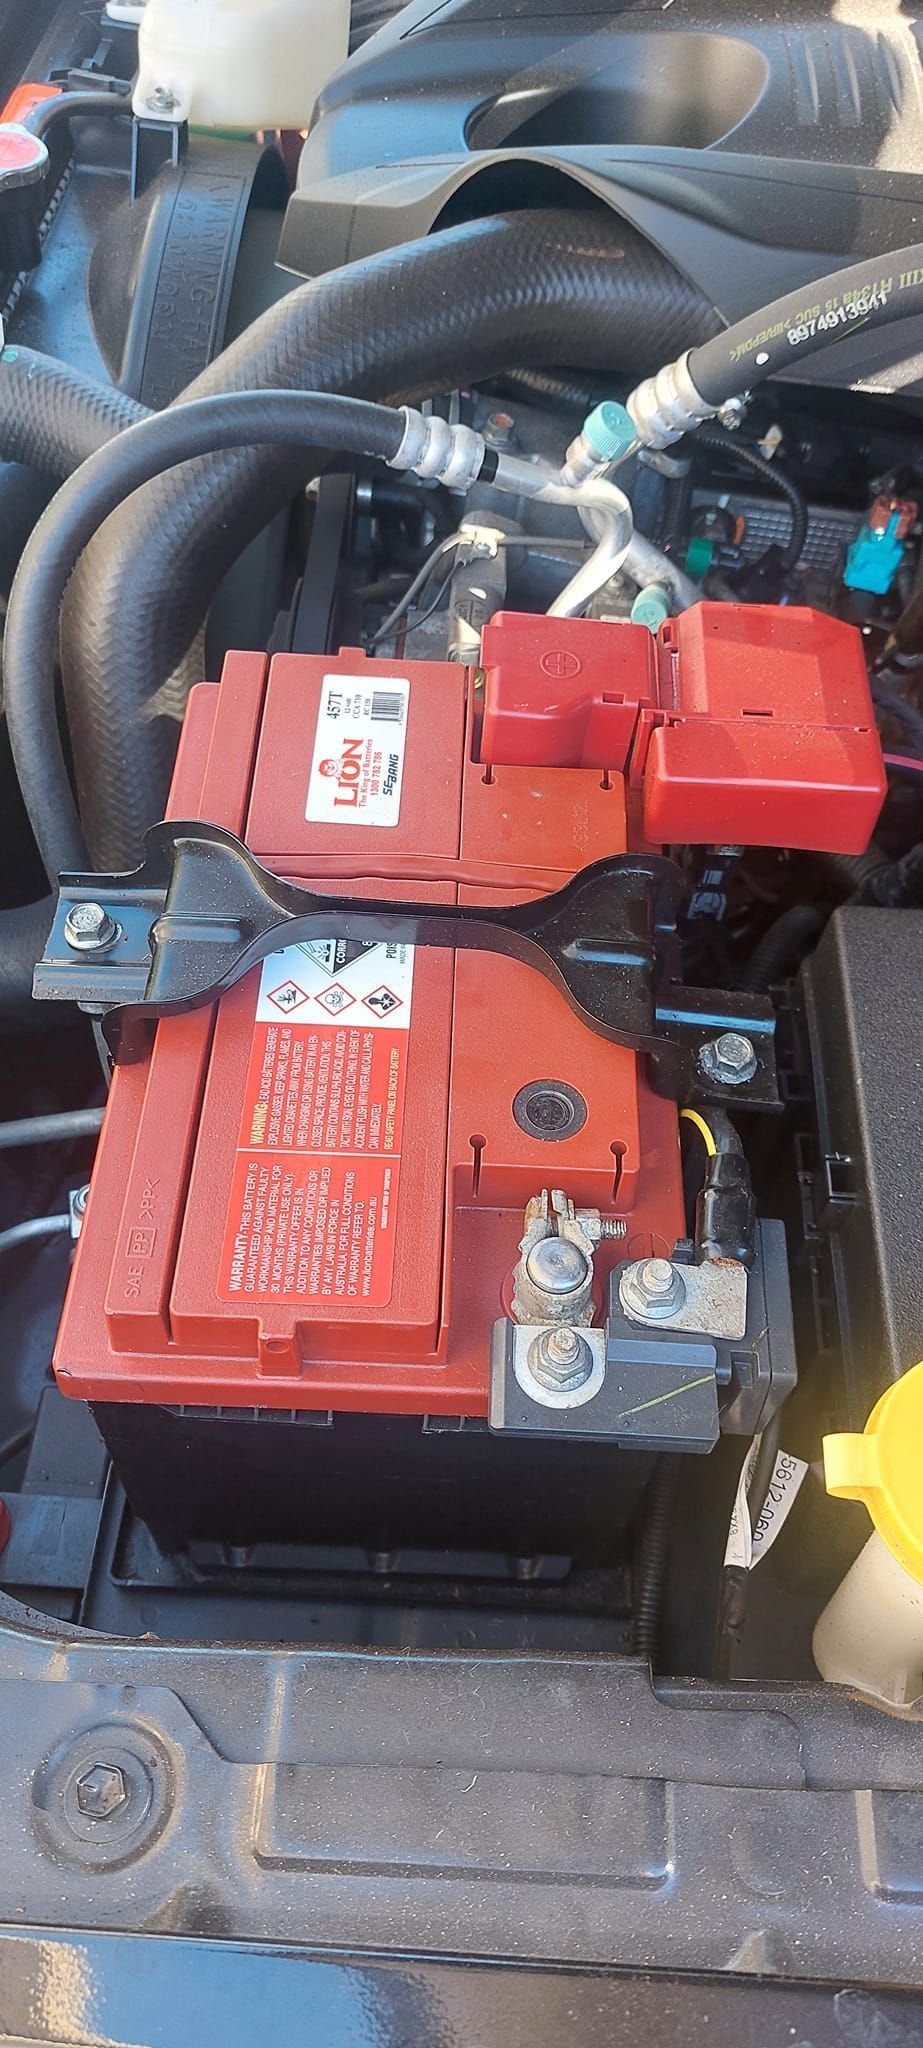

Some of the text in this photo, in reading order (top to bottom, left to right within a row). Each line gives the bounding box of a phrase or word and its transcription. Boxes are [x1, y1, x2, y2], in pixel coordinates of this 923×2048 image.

[786, 292, 888, 346] 8974913941
[325, 690, 342, 719] 457T
[352, 705, 361, 718] CCA
[333, 737, 364, 807] LION
[358, 738, 373, 807] The King of Batteries
[382, 753, 399, 796] SEBANG
[247, 1162, 258, 1170] IS
[242, 1171, 257, 1209] BATTERY
[279, 1196, 290, 1211] USE
[294, 1187, 304, 1195] IN
[341, 1170, 355, 1215] CONDITIONS
[244, 1166, 269, 1291] GUARANTEED AGAINST FAULTY
[257, 1164, 282, 1292] WORKMANSHIP AND MATERIAL FOR
[275, 1212, 290, 1245] (PRIVATE
[290, 1205, 302, 1230] OFFER
[308, 1166, 331, 1294] WARRANTIES IMPOSED OR IMPLIED
[327, 1207, 339, 1233] FORCE
[339, 1215, 351, 1233] FULL
[352, 1213, 363, 1238] REFER
[133, 1232, 147, 1253] PP
[295, 1169, 319, 1294] ADDITION TO ANY CONDITIONS OR
[326, 1234, 336, 1242] IN
[338, 1234, 349, 1250] FOR
[285, 1231, 300, 1274] WARRANTY
[324, 1244, 336, 1265] LAWS
[359, 1195, 377, 1296] www.lionbatteries.com.au
[271, 1247, 285, 1280] MONTHS
[322, 1267, 333, 1282] ANY
[348, 1239, 361, 1283] WARRANTY
[125, 1265, 144, 1297] SAE
[270, 1282, 281, 1293] 30
[283, 1275, 295, 1293] THIS
[321, 1283, 332, 1294] BY
[346, 1283, 357, 1295] OF
